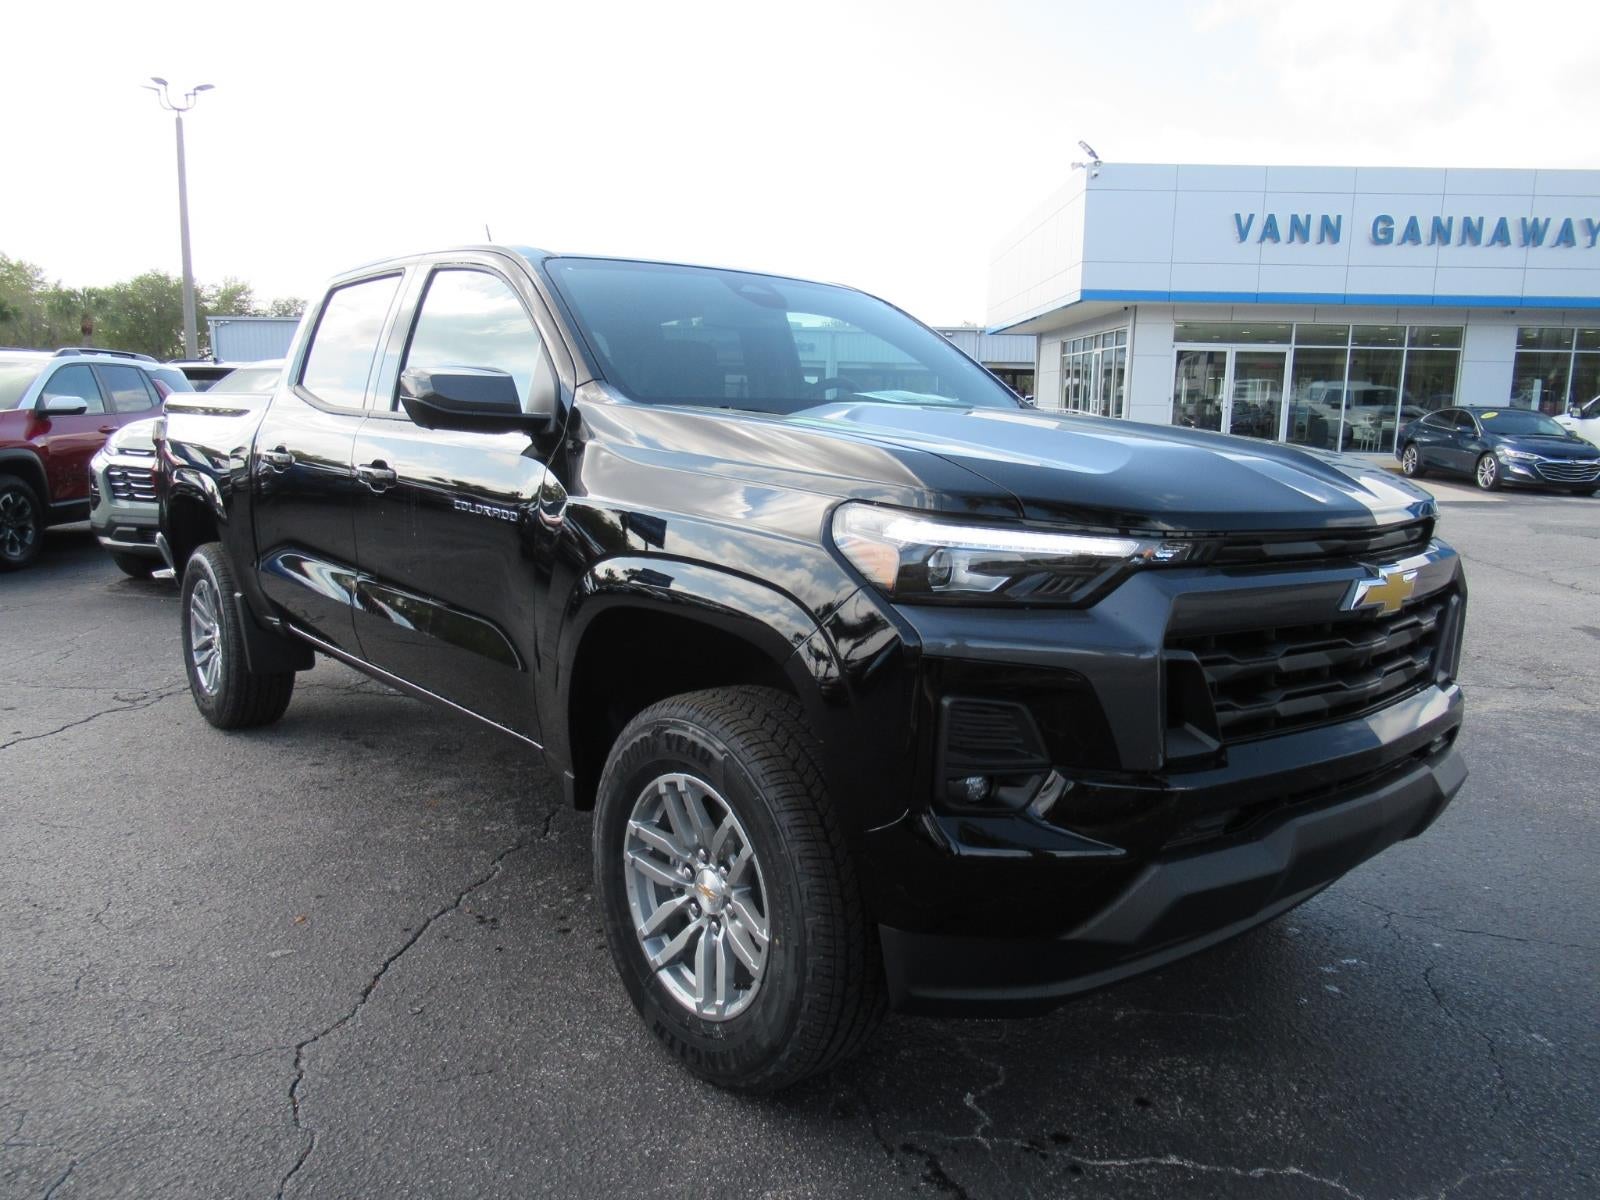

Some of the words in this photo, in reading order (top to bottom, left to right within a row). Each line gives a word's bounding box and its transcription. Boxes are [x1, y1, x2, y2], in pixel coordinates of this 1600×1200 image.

[1234, 213, 1342, 244] VANN
[1371, 214, 1600, 248] GANNAWAY
[454, 500, 518, 521] COLORADO
